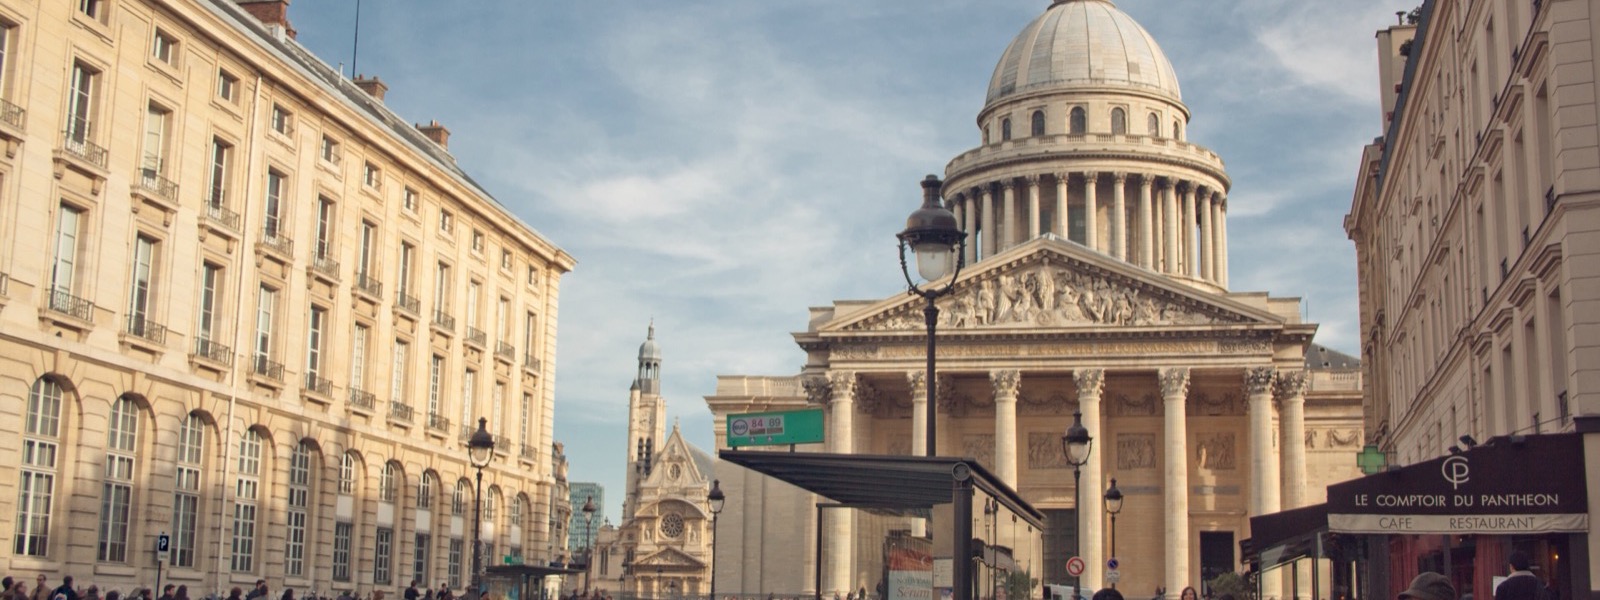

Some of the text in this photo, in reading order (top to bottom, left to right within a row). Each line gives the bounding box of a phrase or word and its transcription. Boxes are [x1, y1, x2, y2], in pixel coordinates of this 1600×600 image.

[751, 417, 781, 428] 84 89
[1355, 493, 1559, 507] LE COMPTOIR DU PANTHEON
[1379, 517, 1536, 529] CAFE RESTAURANT
[161, 537, 167, 550] P
